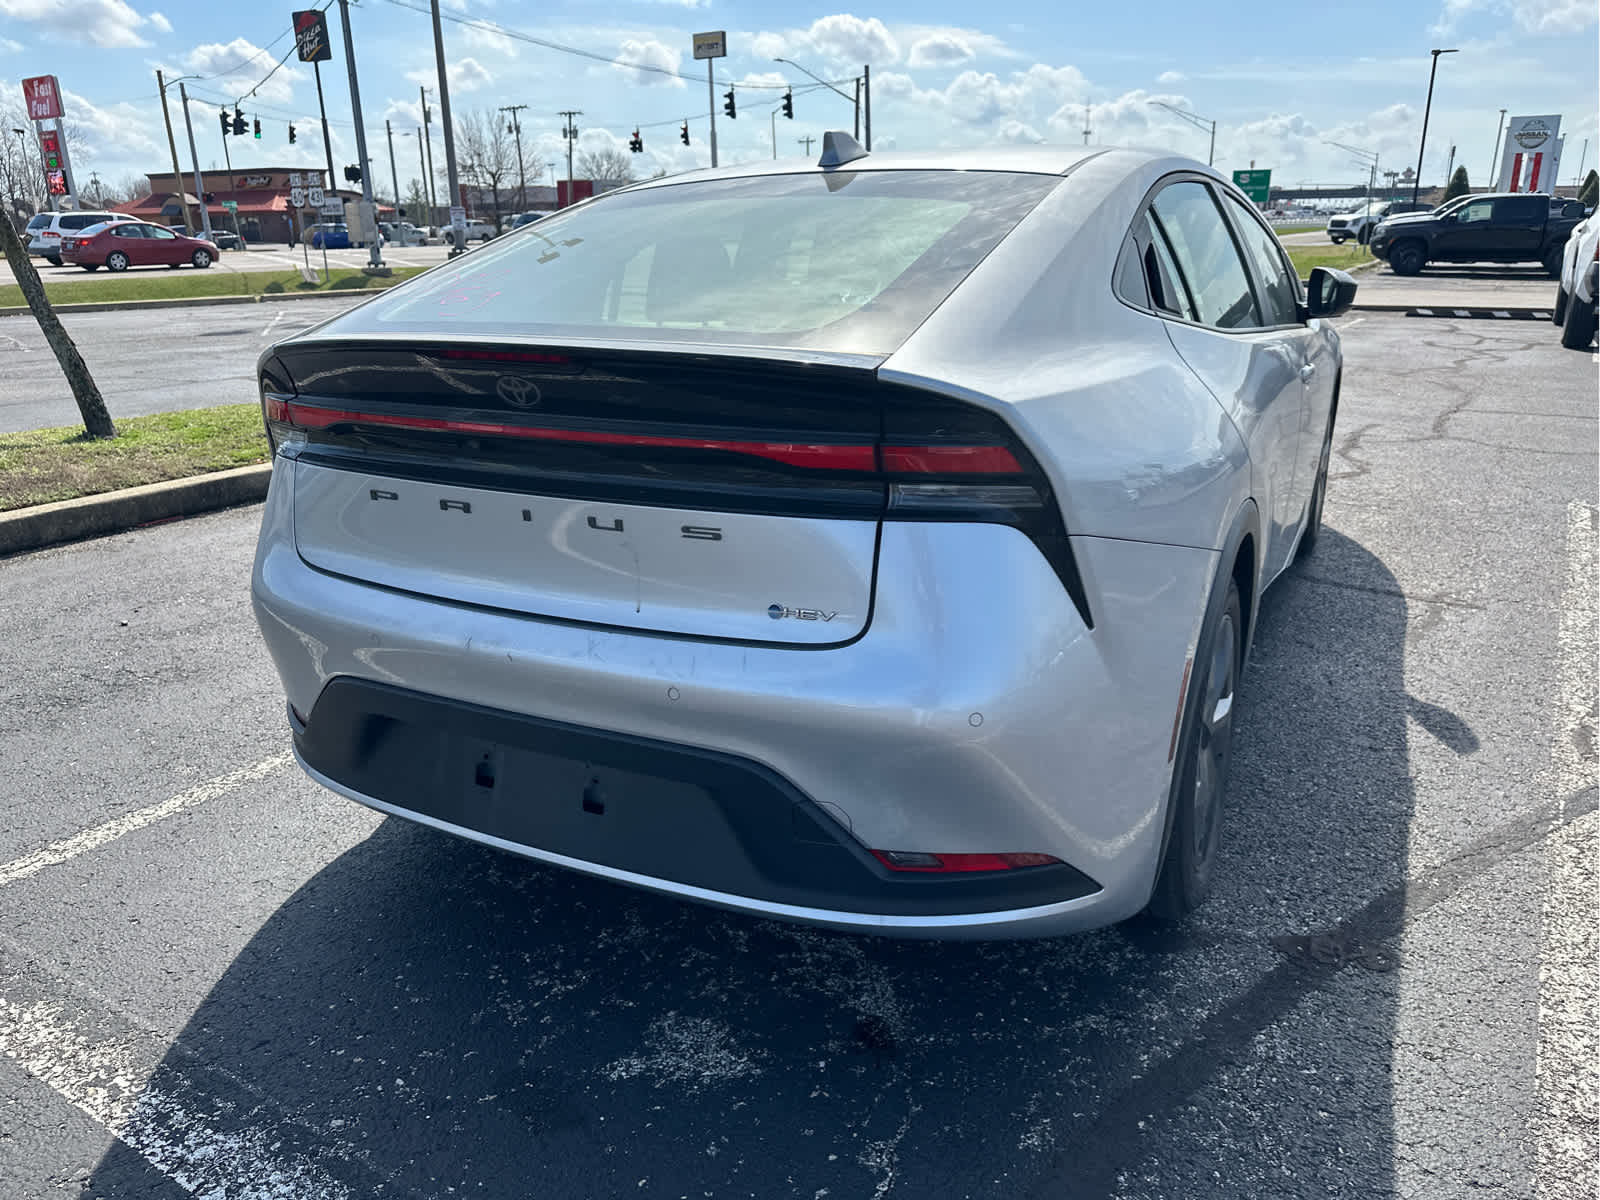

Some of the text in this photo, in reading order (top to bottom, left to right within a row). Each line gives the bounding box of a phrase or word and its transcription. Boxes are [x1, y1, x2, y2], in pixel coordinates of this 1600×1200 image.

[296, 25, 321, 48] Pizza
[302, 36, 321, 58] Hut
[33, 80, 52, 97] Fast
[31, 98, 50, 117] Fuel
[369, 489, 723, 541] PRIUS
